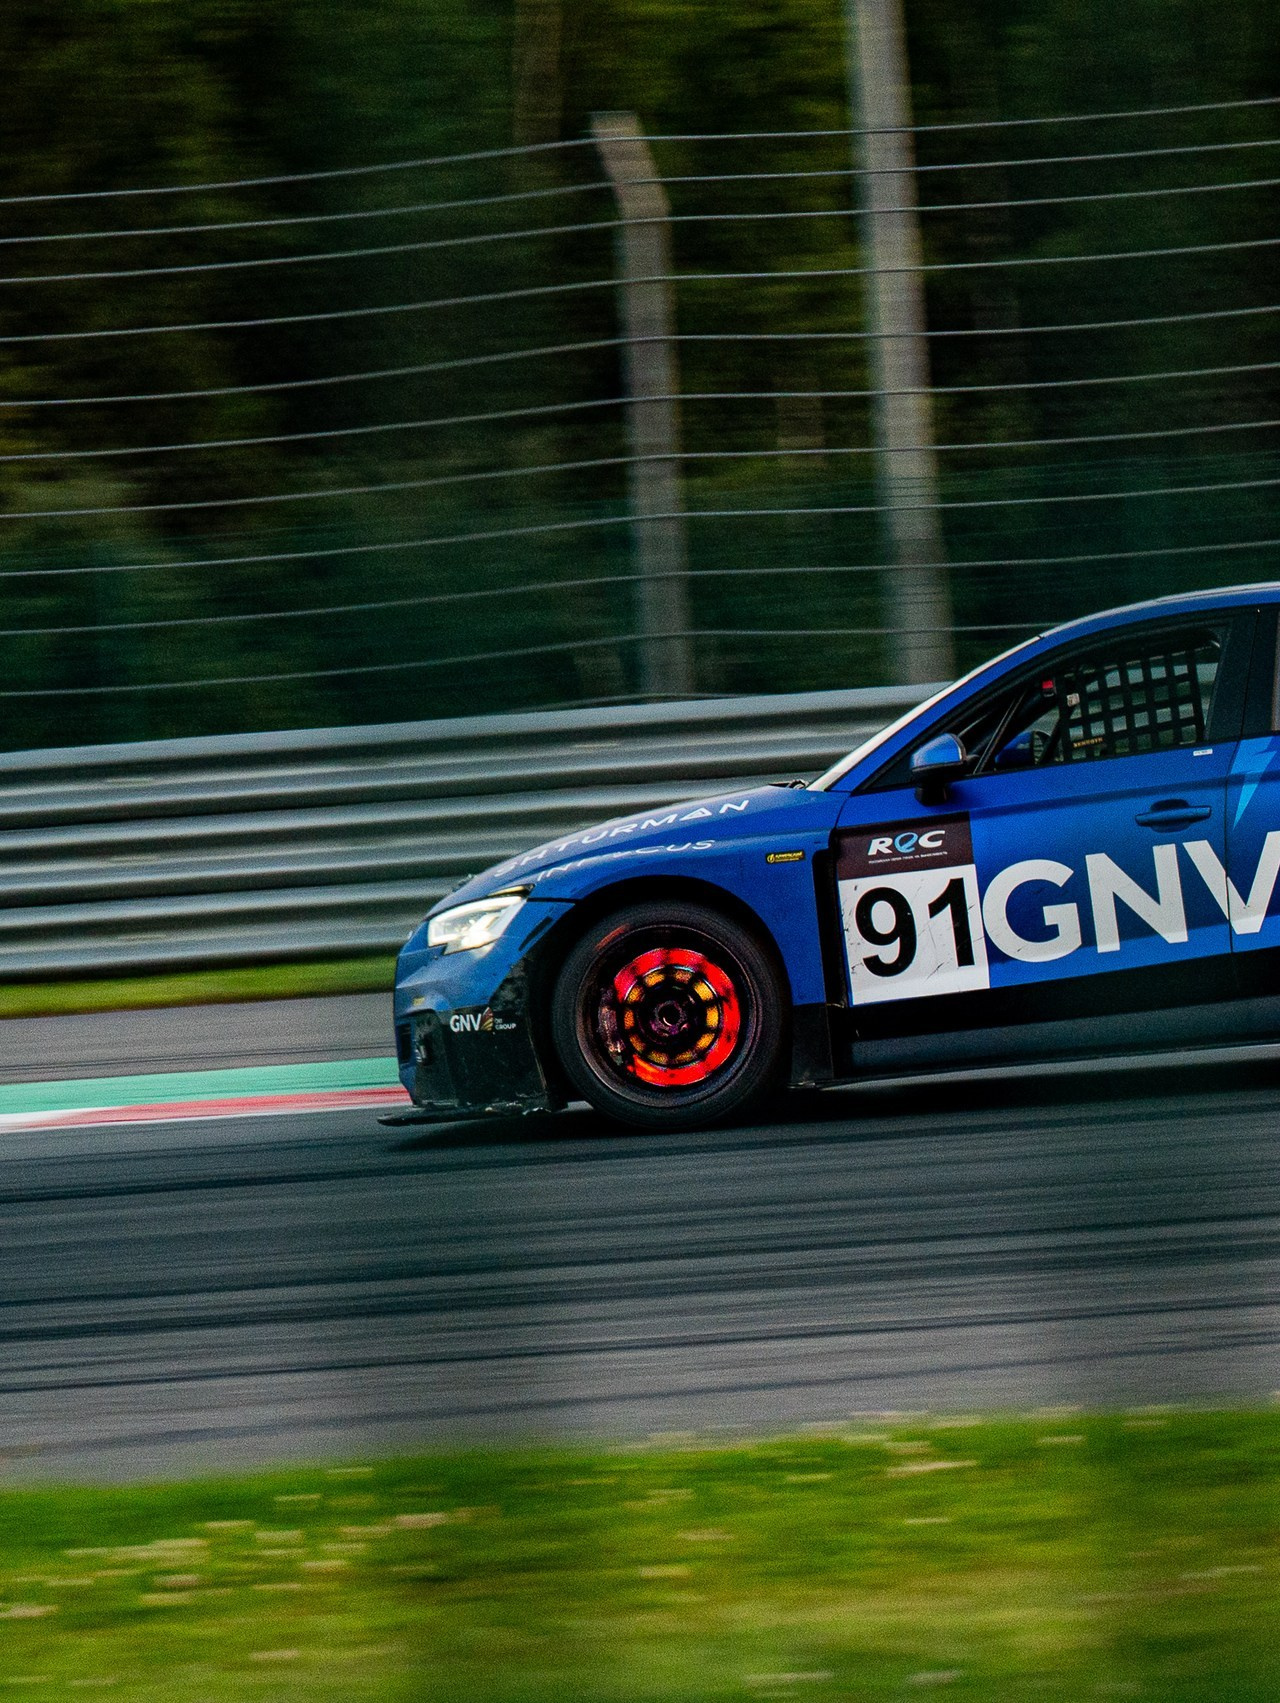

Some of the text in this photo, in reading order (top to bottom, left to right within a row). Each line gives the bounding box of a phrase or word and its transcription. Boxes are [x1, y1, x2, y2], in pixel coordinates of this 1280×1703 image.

[494, 799, 750, 878] SHTURMAN
[855, 878, 976, 978] 91
[449, 1013, 482, 1033] GNV
